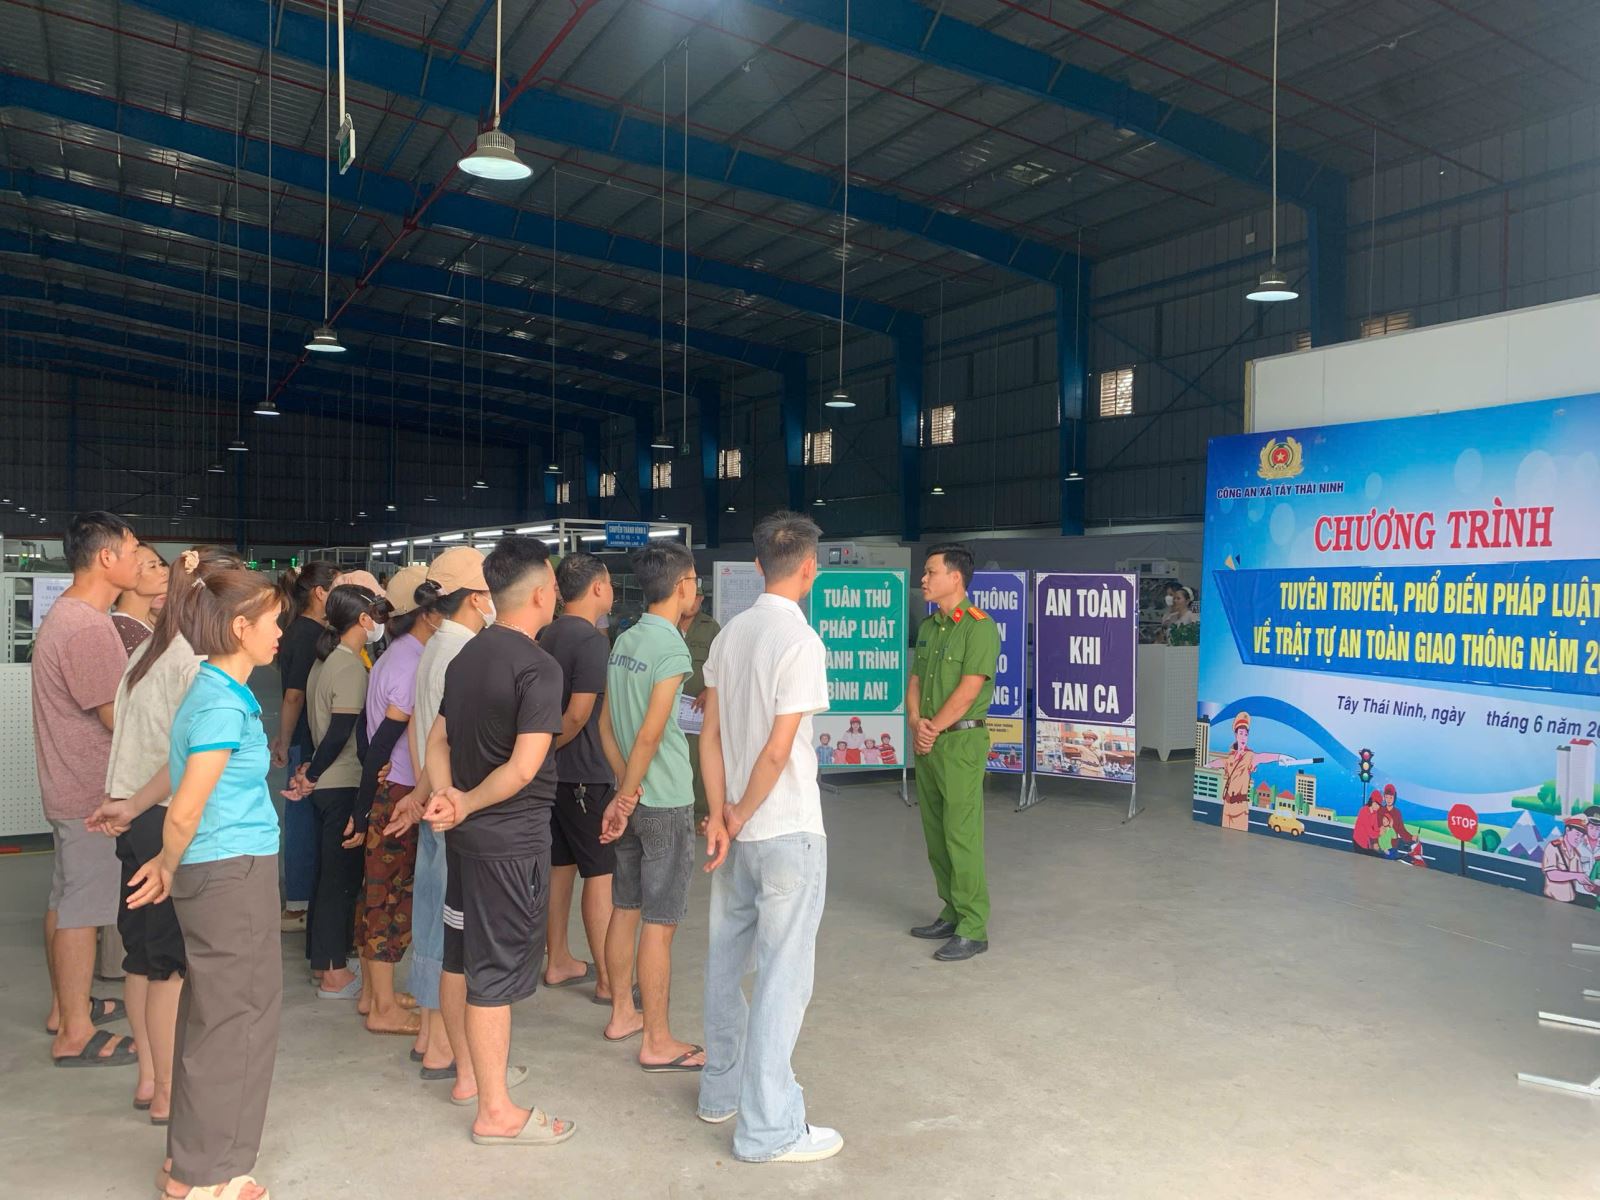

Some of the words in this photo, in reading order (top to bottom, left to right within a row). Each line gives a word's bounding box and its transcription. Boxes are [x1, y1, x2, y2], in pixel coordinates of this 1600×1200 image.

[1244, 487, 1257, 498] AN
[1319, 482, 1344, 493] NINH
[1314, 507, 1436, 552] CHƯƠNG
[1447, 496, 1554, 549] TRÌNH
[824, 585, 860, 608] TUÂN
[864, 581, 891, 608] THỦ
[972, 587, 1018, 611] THÔNG
[1045, 588, 1072, 616] AN
[1076, 583, 1127, 618] TOÀN
[1280, 576, 1328, 611] TUYÊN
[1332, 572, 1399, 616] TRUYỀN,
[1403, 570, 1442, 613] PHỔ
[1444, 572, 1488, 615] BIẾN
[1492, 576, 1546, 616] PHÁP
[1552, 576, 1600, 626] LUẬT
[820, 616, 858, 639] PHÁP
[861, 616, 896, 643] LUẬT
[825, 646, 854, 670] ÀNH
[858, 646, 900, 670] TRÌNH
[1070, 636, 1100, 665] KHI
[1253, 617, 1272, 654] VỀ
[1275, 621, 1312, 662] TRẬT
[1316, 625, 1337, 664] TỰ
[1338, 628, 1361, 659] AN
[1366, 624, 1410, 662] TOÀN
[1414, 631, 1456, 665] GIAO
[1462, 628, 1525, 670] THÔNG
[1529, 630, 1579, 674] NĂM
[1584, 640, 1600, 675] 2
[828, 678, 859, 700] BÌNH
[864, 682, 888, 700] AN!
[1052, 682, 1088, 712] TAN
[1094, 684, 1120, 714] CA
[1337, 695, 1359, 715] Tây
[1363, 698, 1390, 715] Thái
[1392, 700, 1428, 720] Ninh,
[1432, 705, 1466, 727] ngày
[1486, 710, 1529, 734] tháng
[1533, 715, 1544, 734] 6
[1546, 717, 1582, 736] năm
[1451, 815, 1477, 830] STOP
